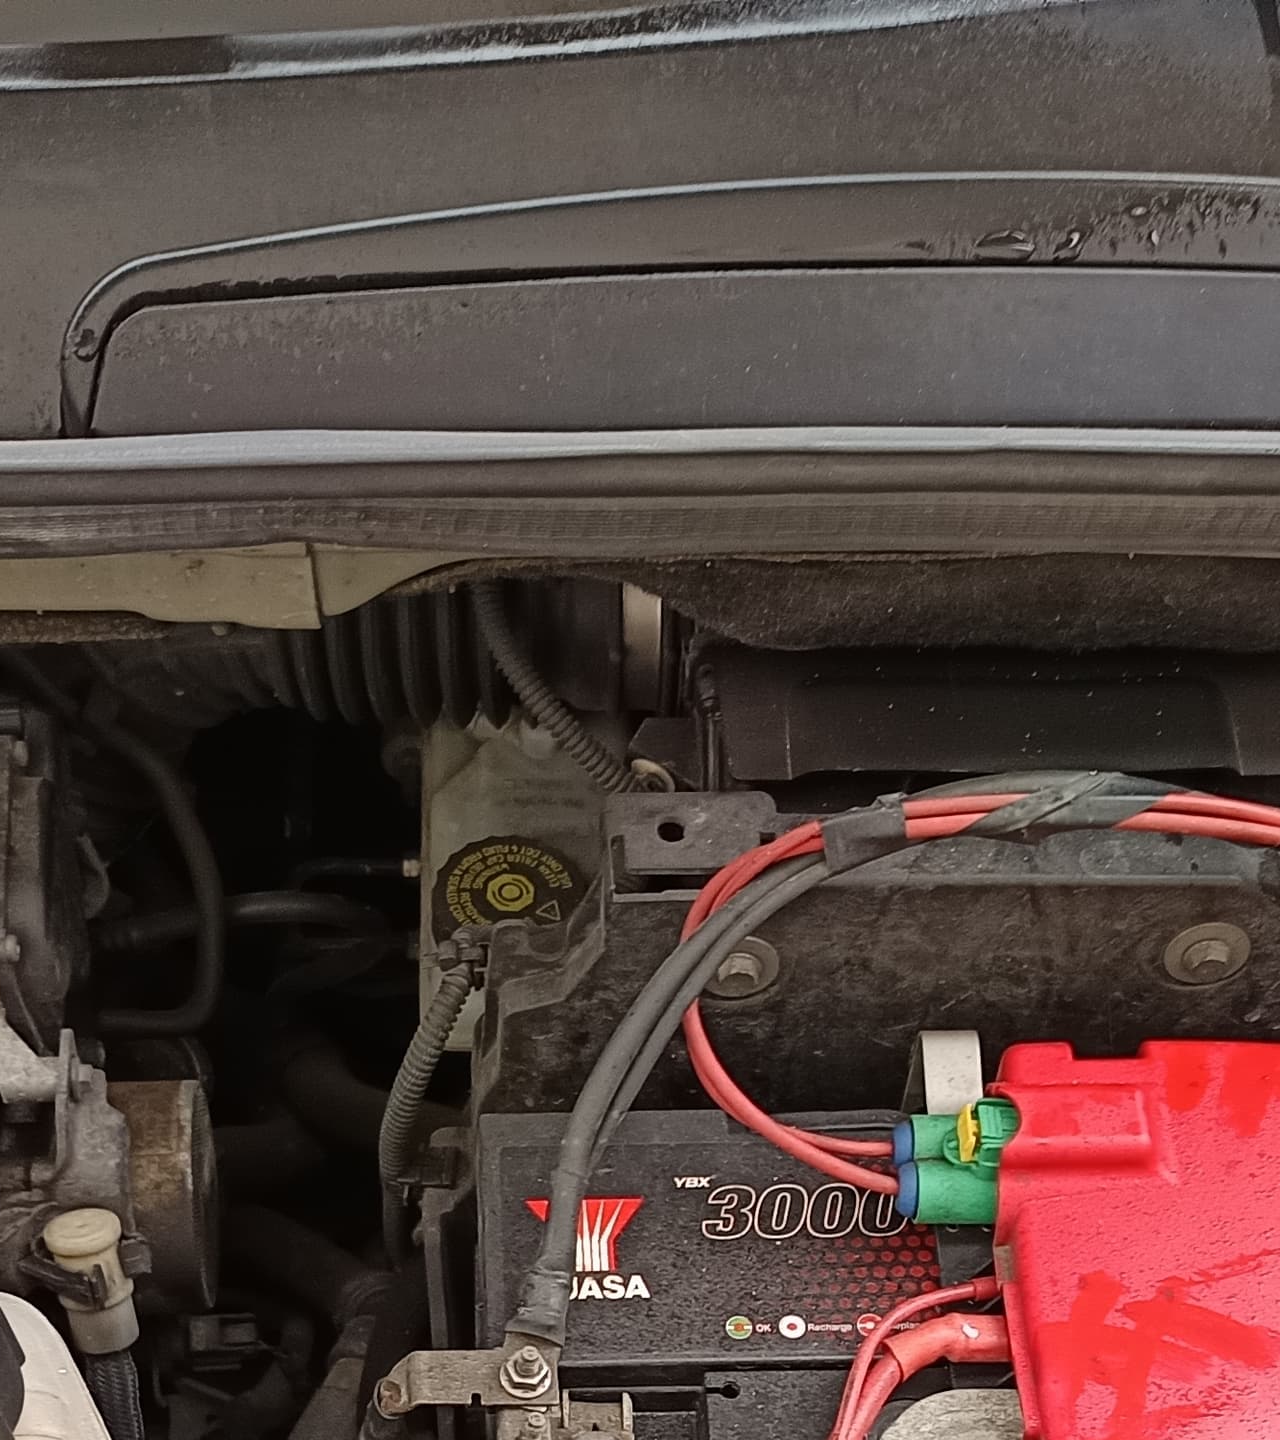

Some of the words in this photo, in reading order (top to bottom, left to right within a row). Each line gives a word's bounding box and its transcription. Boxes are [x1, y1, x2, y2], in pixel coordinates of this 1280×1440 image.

[487, 855, 504, 865] CAP
[673, 1176, 710, 1189] YBX
[701, 1183, 908, 1240] 3000
[807, 1322, 853, 1334] Recharge
